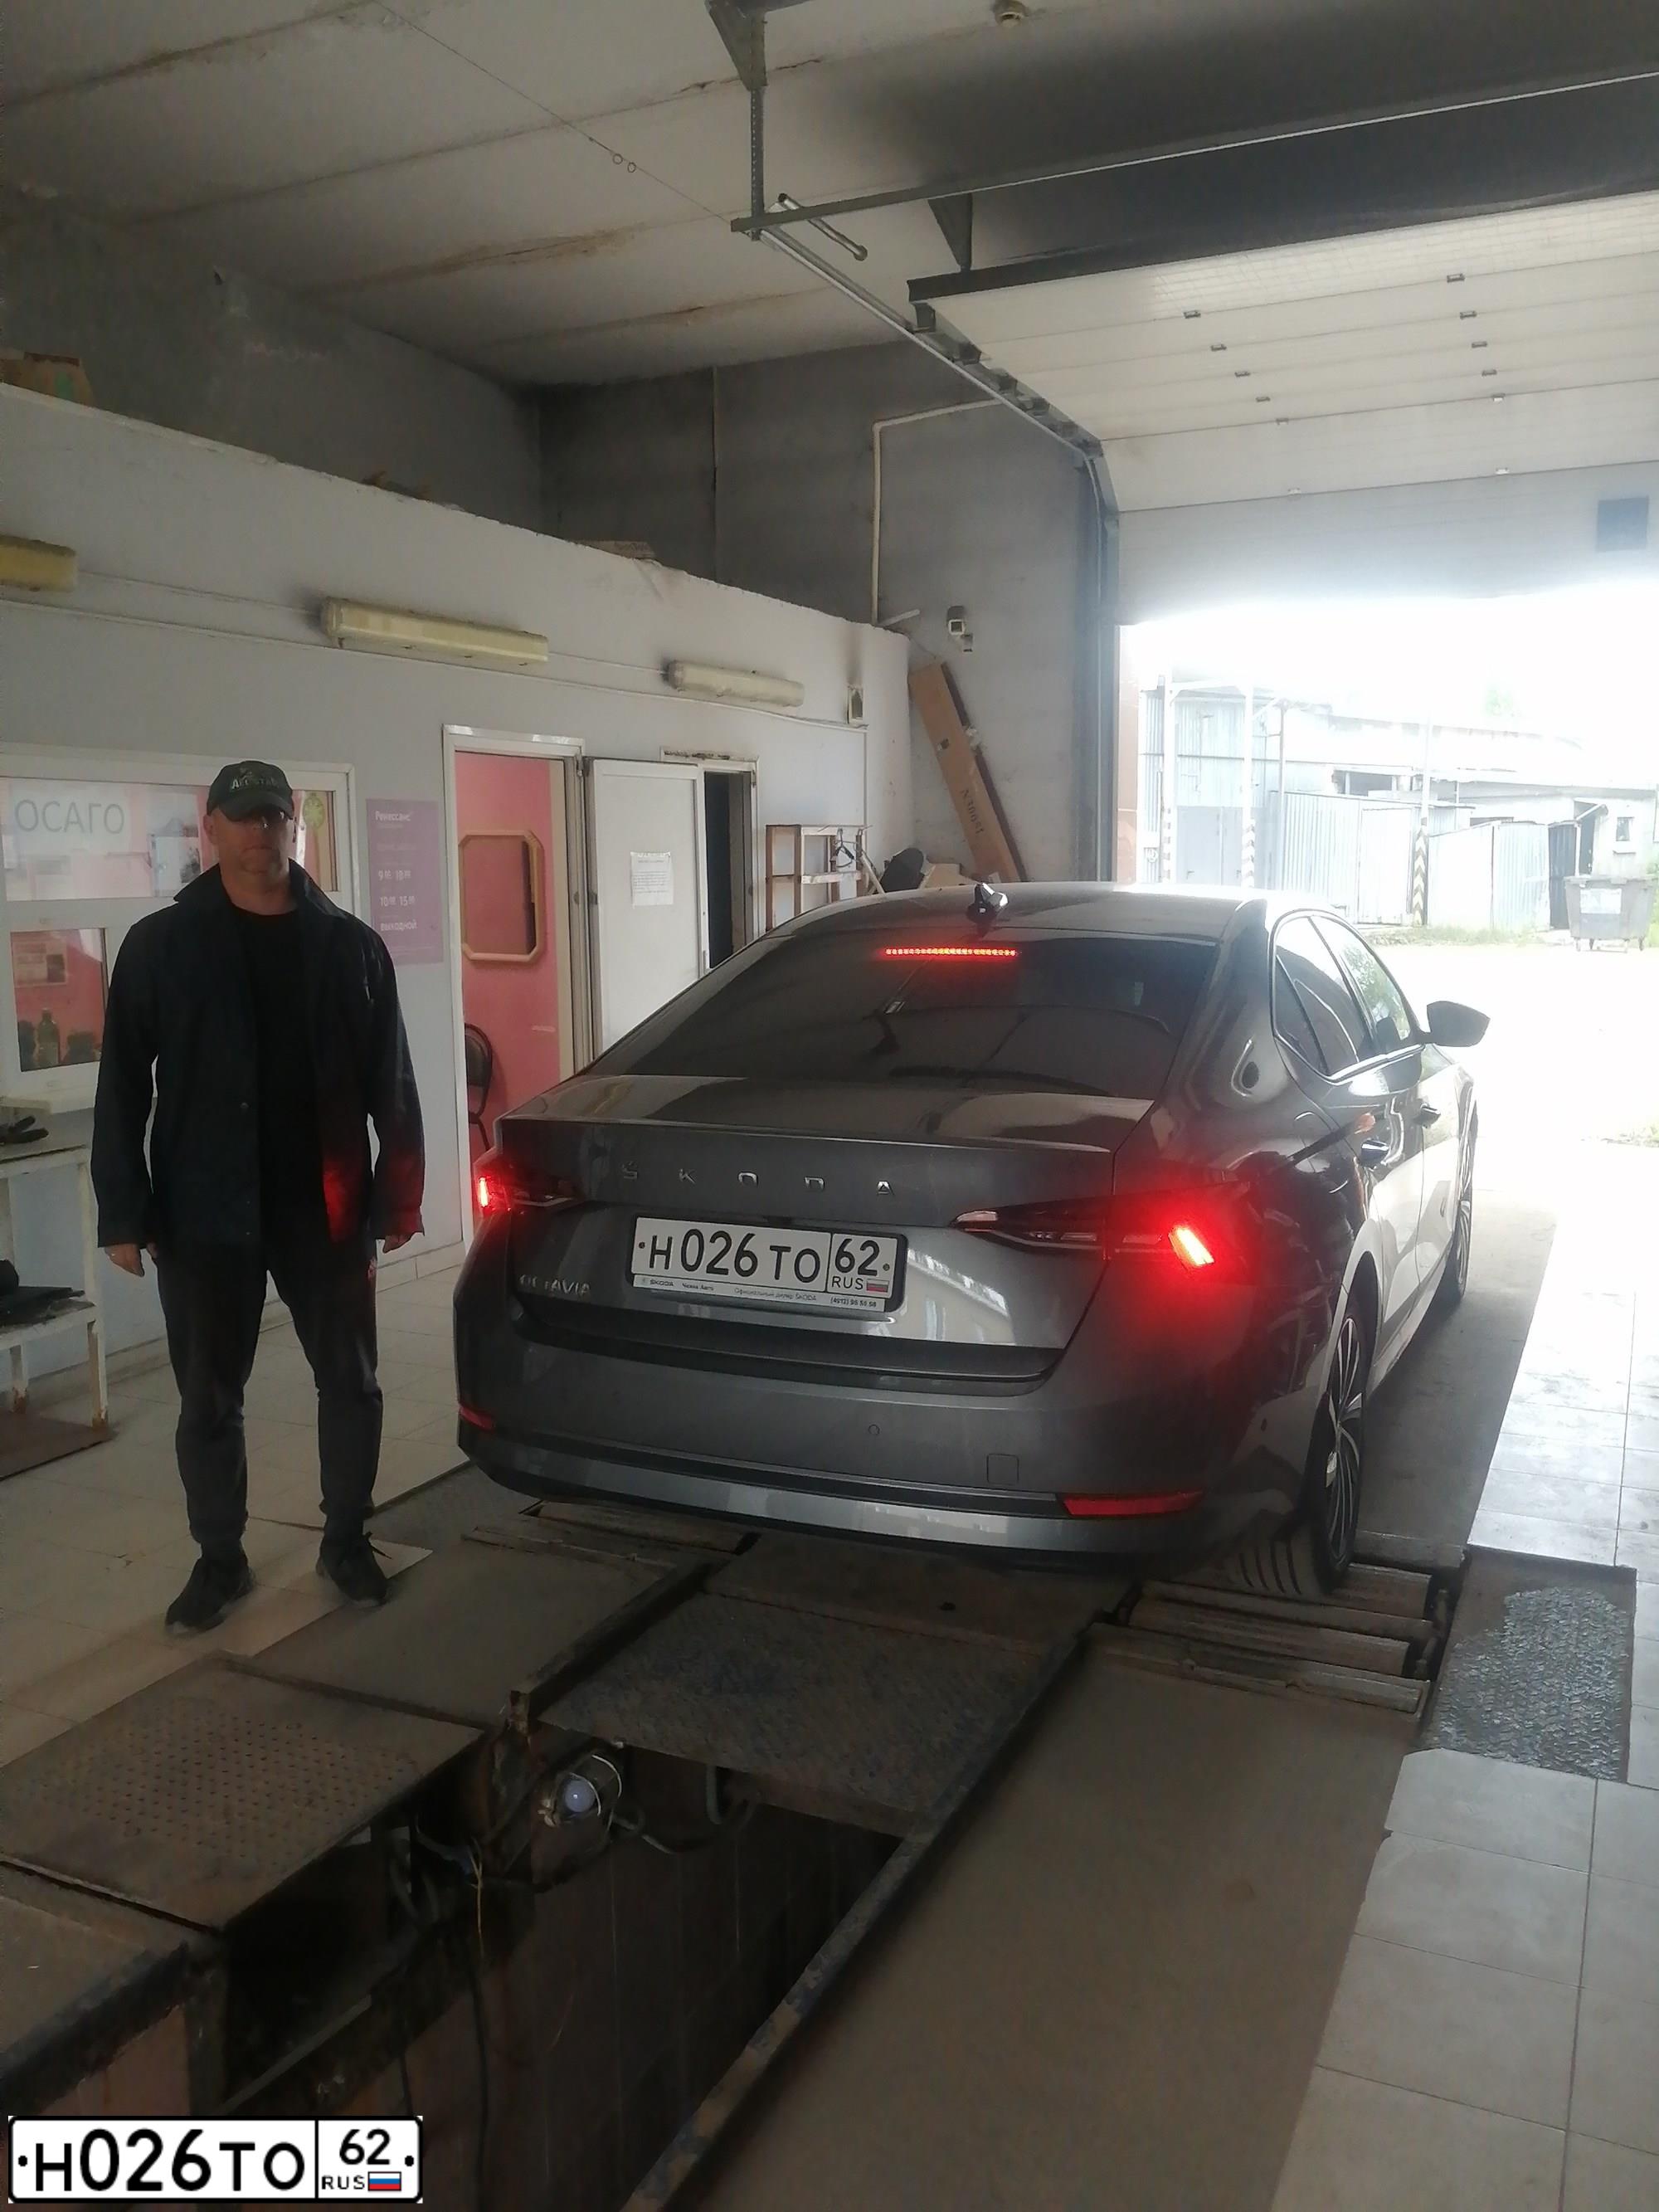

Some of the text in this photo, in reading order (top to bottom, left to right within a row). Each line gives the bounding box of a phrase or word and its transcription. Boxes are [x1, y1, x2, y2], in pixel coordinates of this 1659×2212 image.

[14, 798, 125, 835] ОСАГО
[834, 1238, 880, 1276] 62
[832, 1276, 864, 1290] RUS
